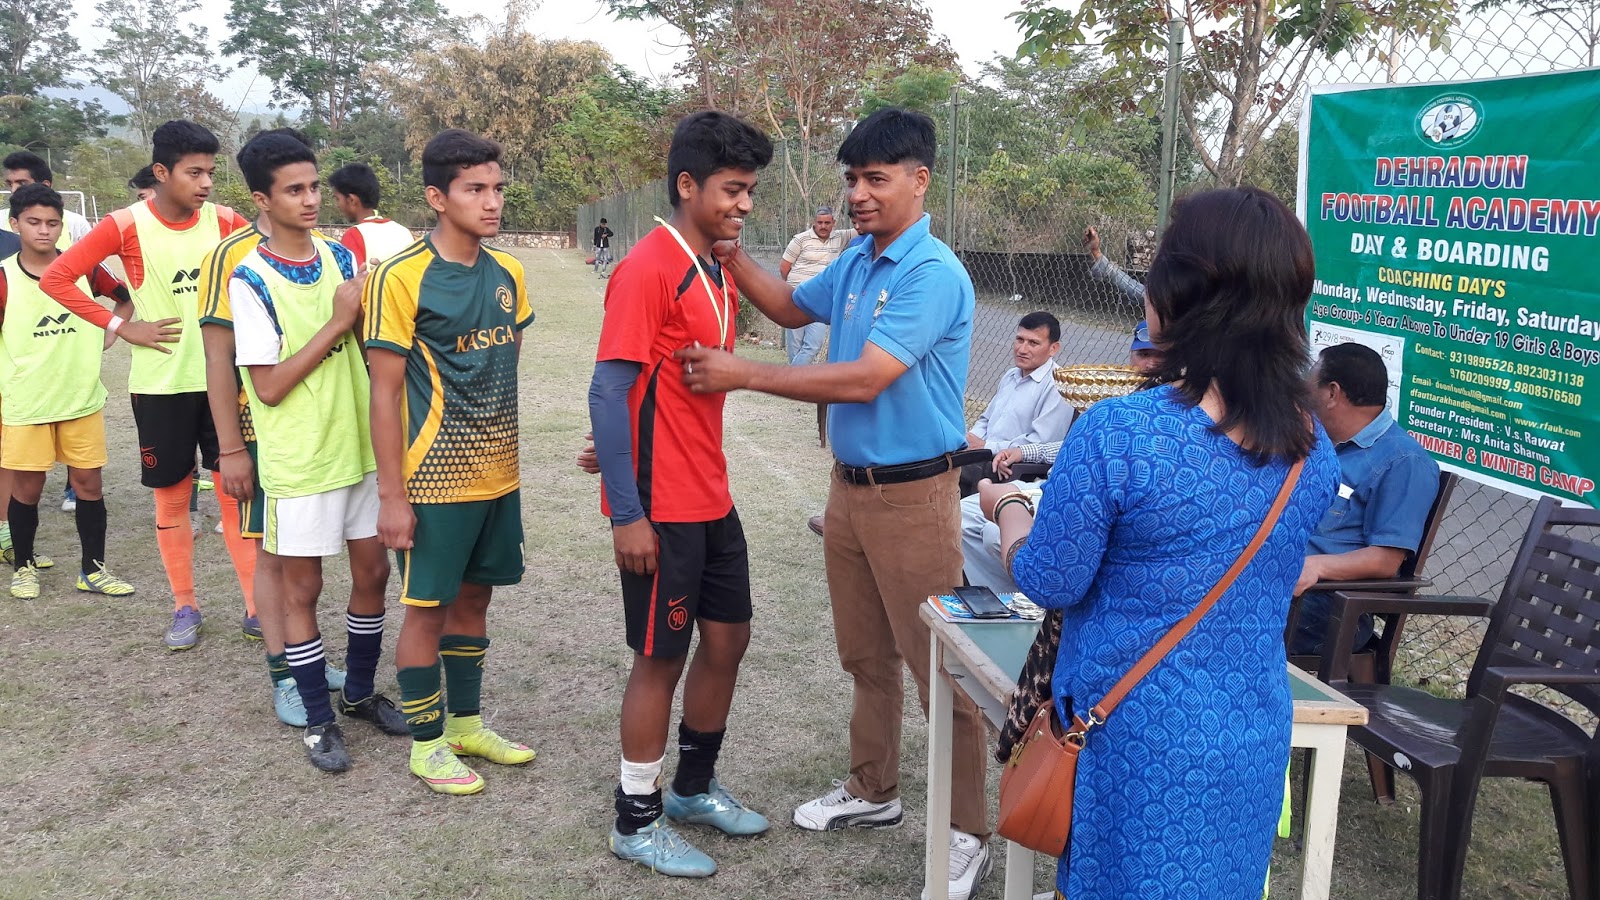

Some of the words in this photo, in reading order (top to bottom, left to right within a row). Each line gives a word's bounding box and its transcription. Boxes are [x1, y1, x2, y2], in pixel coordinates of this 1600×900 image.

[1374, 155, 1528, 188] DEHRADUN
[1321, 192, 1439, 227] FOOTBALL
[1446, 196, 1600, 236] ACADEMY
[1350, 233, 1384, 256] DAY
[1392, 236, 1407, 259] &
[1418, 239, 1549, 271] BOARDING
[1378, 266, 1452, 292] COACHING
[1458, 276, 1506, 298] DAY'S
[1312, 279, 1361, 303] Monday,
[1366, 286, 1446, 318] Wednesday,
[1453, 299, 1510, 326] Friday,
[33, 326, 77, 338] NIVIA
[1312, 302, 1328, 318] Age
[1330, 305, 1363, 324] Group-
[1365, 309, 1371, 324] 6
[1374, 311, 1398, 329] Year
[1401, 316, 1430, 336] Above
[1433, 321, 1446, 338] To
[1450, 325, 1490, 345] Under
[1495, 330, 1508, 348] 19
[1513, 334, 1545, 355] Girls
[1549, 339, 1561, 356] &
[1564, 342, 1598, 367] Boys
[1449, 351, 1584, 388] 9319895526,8923031138
[1450, 368, 1581, 407] 9760209999,9808576580
[1409, 401, 1445, 422] Founder
[1449, 410, 1495, 433] President
[1525, 430, 1565, 453] Rawat
[1410, 388, 1506, 421] dfauttarakhand@gmail.com
[1514, 416, 1581, 438] www.rfauk.com
[1408, 415, 1452, 439] Secretary
[1461, 428, 1481, 445] Mrs
[1484, 434, 1510, 452] Anita
[1513, 442, 1551, 465] Sharma
[144, 455, 155, 467] 90
[1466, 445, 1476, 463] &
[1481, 450, 1536, 481] WINTER
[1540, 467, 1594, 497] CAMP
[672, 611, 683, 626] 90
